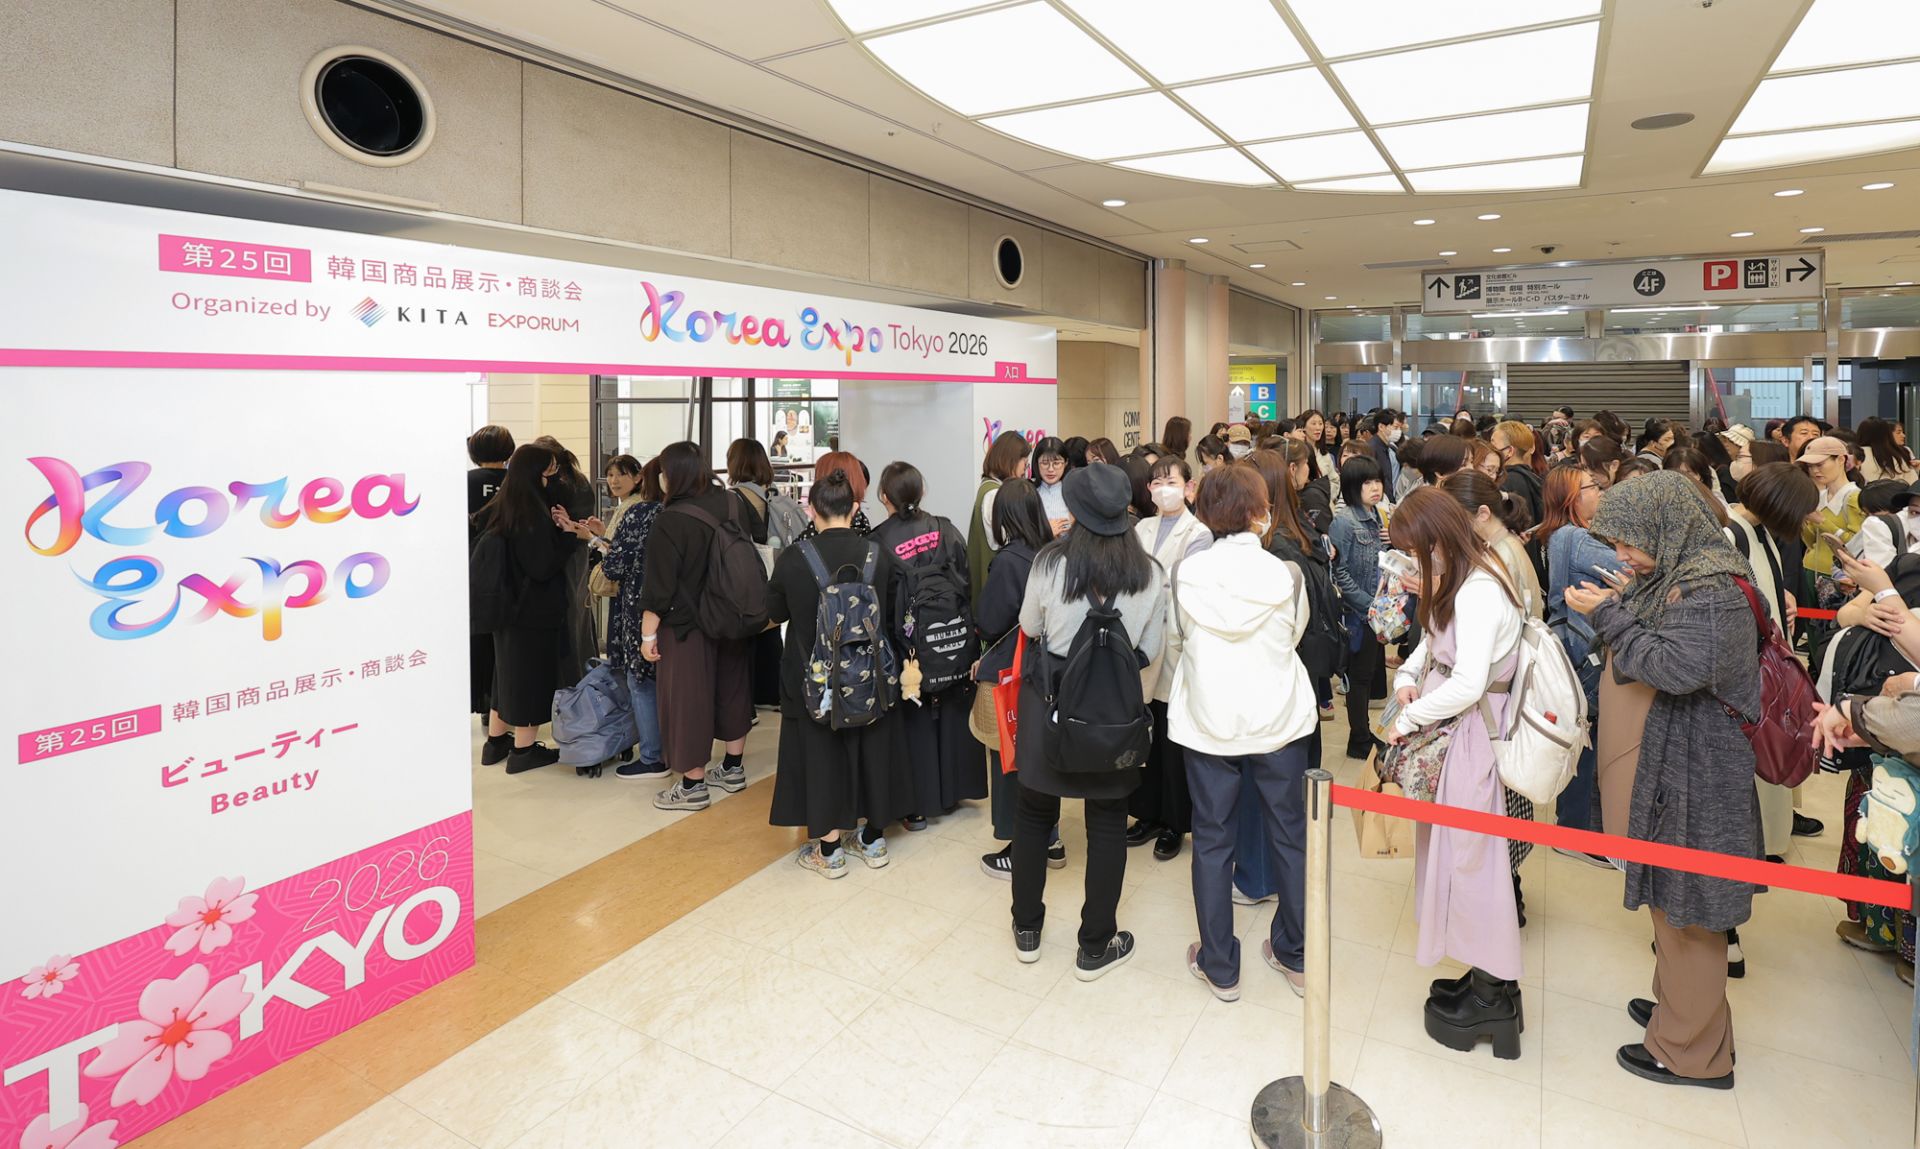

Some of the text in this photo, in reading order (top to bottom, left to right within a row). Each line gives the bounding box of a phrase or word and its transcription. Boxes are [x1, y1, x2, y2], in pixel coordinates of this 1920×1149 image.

[182, 241, 583, 301] 第25回 韓国商品展示・商談会
[1636, 276, 1660, 293] 4F
[1711, 264, 1732, 287] P
[172, 292, 580, 332] Organized by KITA EXPORUM
[639, 281, 988, 367] Korea Expo Tokyo 2026
[1004, 366, 1019, 378] 入口
[1258, 386, 1270, 400] B
[1258, 405, 1270, 418] C
[25, 456, 421, 557] Korea
[68, 551, 391, 641] Expo
[34, 649, 428, 756] 第25回 韓国商品展示・商談会
[161, 721, 359, 788] ビューティー
[211, 769, 320, 815] Beauty
[303, 836, 450, 932] 2026
